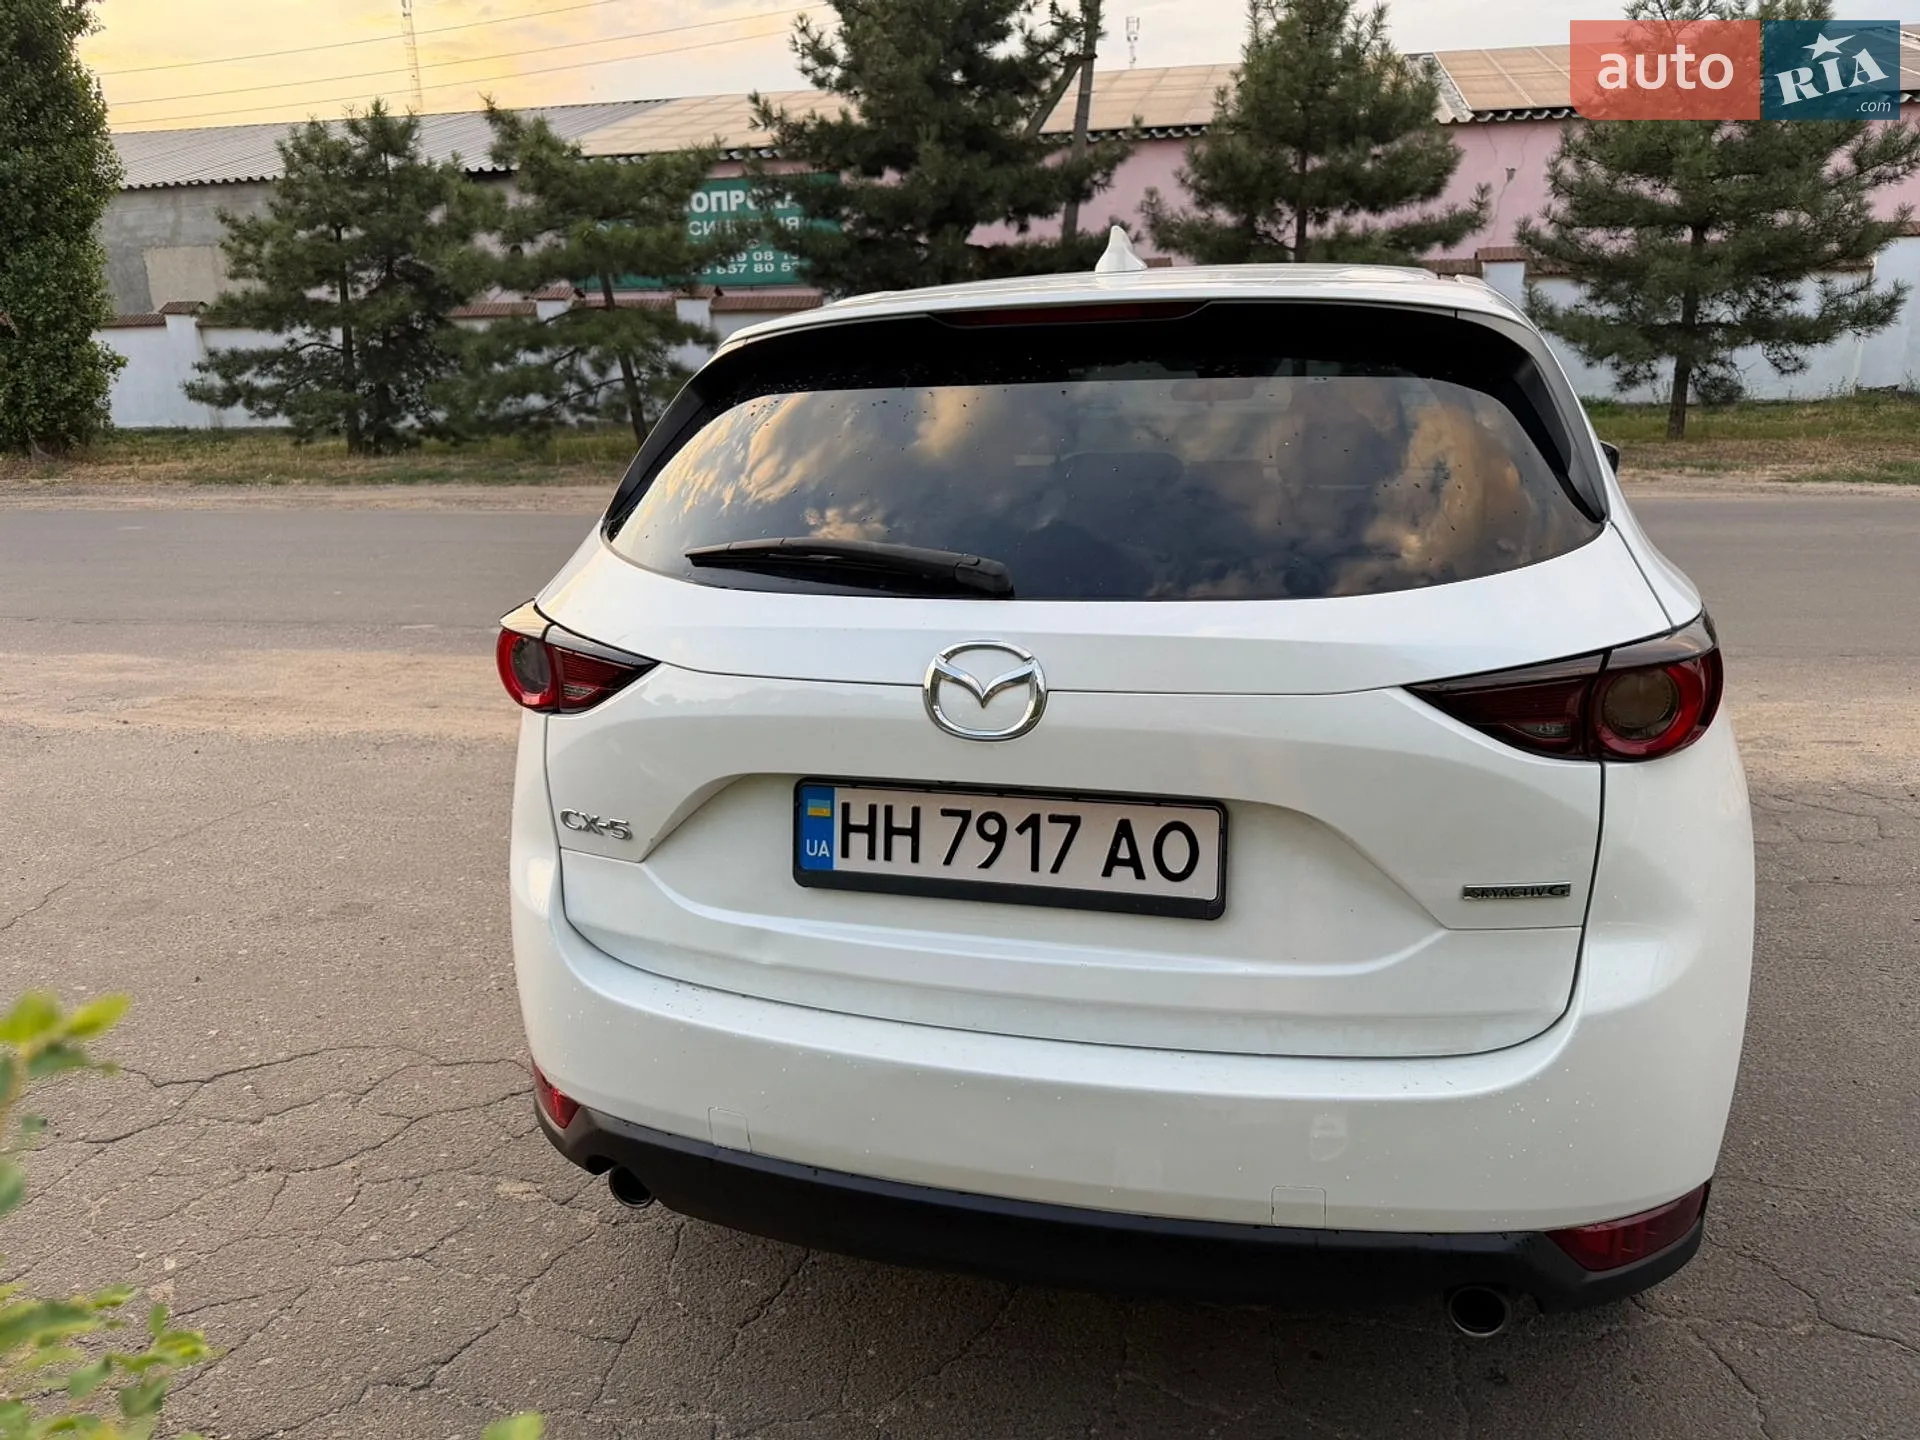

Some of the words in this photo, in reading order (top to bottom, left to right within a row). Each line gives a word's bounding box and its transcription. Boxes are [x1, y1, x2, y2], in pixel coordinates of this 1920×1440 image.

[753, 262, 775, 274] 80
[559, 807, 633, 841] CX-5
[805, 839, 831, 859] UA
[840, 801, 921, 864] HH
[940, 807, 1082, 875] 7917
[1101, 818, 1201, 883] AO
